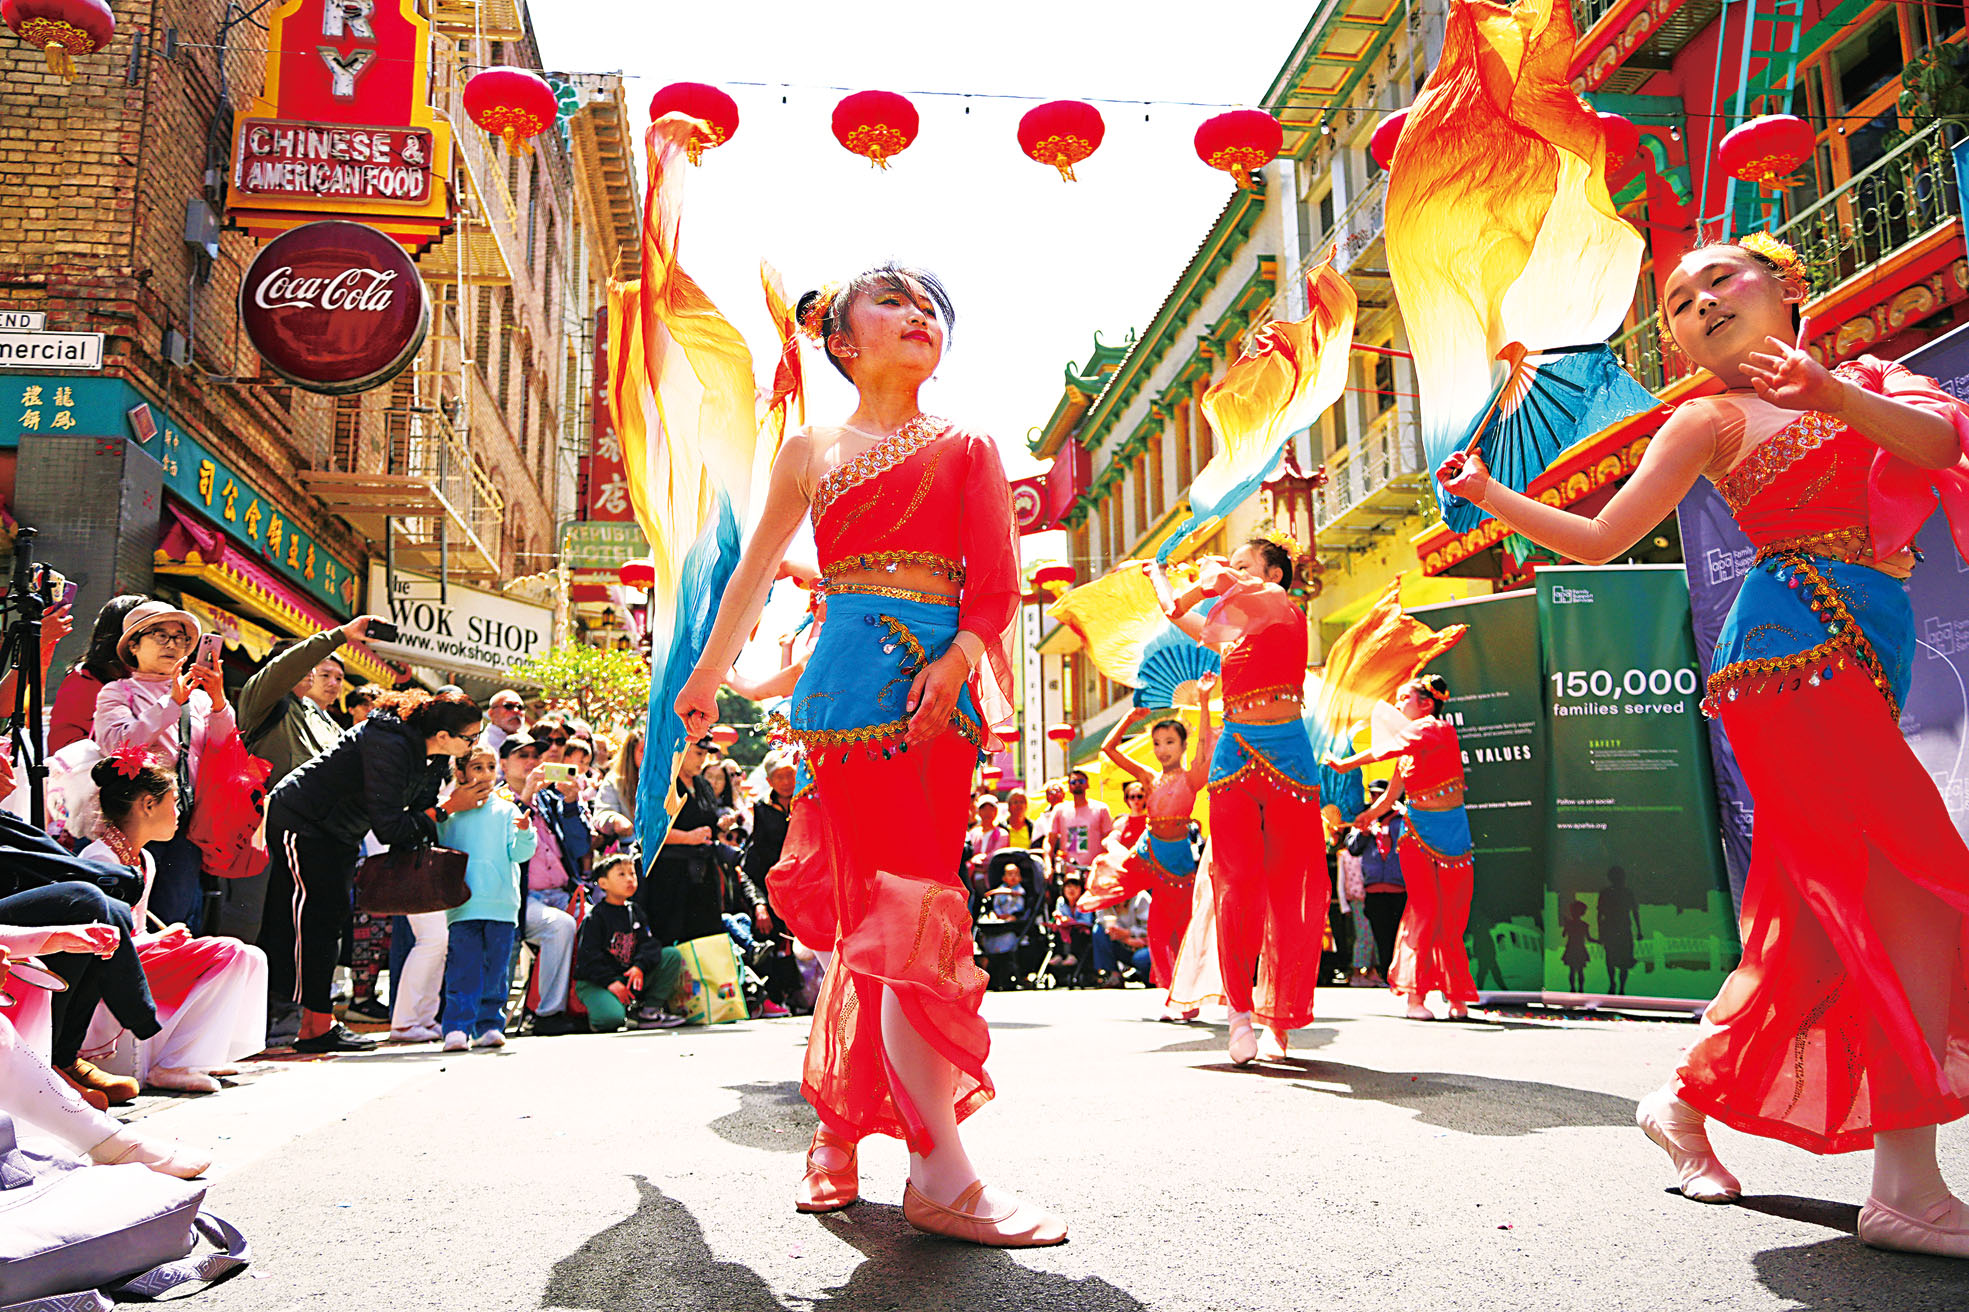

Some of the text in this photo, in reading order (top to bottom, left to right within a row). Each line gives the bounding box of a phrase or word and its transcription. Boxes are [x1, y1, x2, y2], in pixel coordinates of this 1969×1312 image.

[250, 127, 425, 165] CHINESE &
[247, 161, 424, 197] AMERICAN FOOD
[255, 266, 399, 312] Coca-Cola
[566, 526, 641, 543] REPUBLI
[394, 575, 411, 595] he
[390, 599, 539, 655] WOK SHOP
[1551, 668, 1697, 700] 150,000
[1553, 701, 1685, 716] families served
[1475, 745, 1531, 763] VALUES
[1589, 739, 1621, 748] SAFETY
